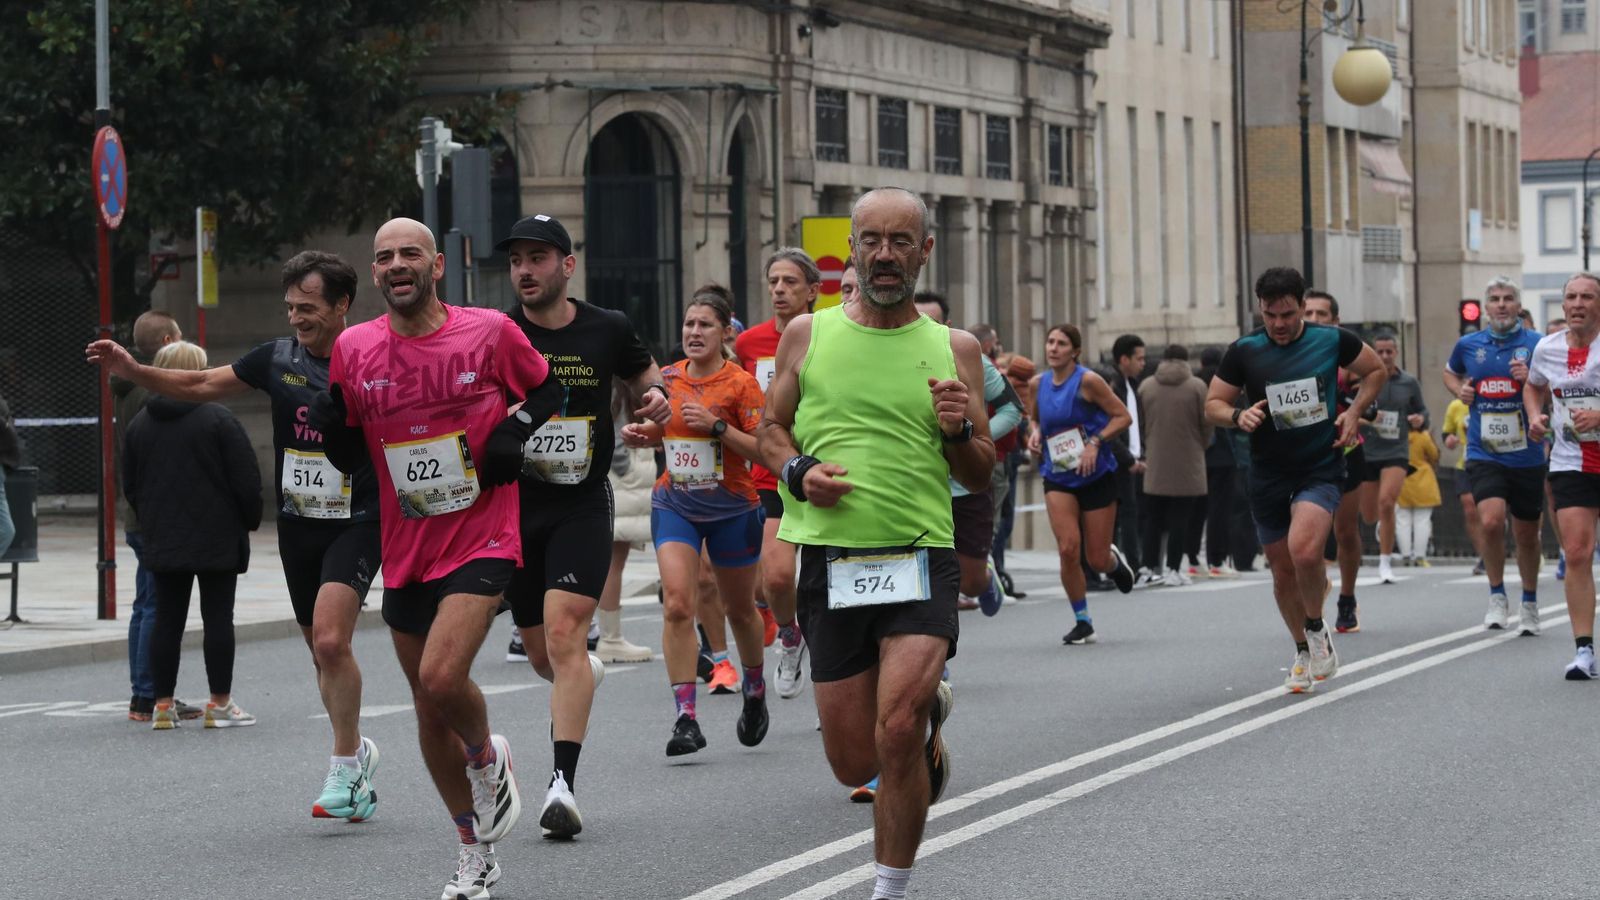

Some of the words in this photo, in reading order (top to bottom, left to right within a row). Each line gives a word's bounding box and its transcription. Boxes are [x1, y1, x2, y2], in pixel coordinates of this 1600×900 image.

[568, 378, 600, 386] OURENSE
[1480, 380, 1517, 394] ABRIL
[1276, 389, 1310, 407] 1465
[545, 423, 563, 431] CIBRÁN
[1488, 424, 1509, 435] 558
[409, 447, 428, 456] CARLOS
[532, 435, 576, 453] 2725
[674, 452, 699, 468] 396
[294, 469, 324, 488] 514
[407, 459, 442, 482] 622
[854, 575, 895, 594] 574
